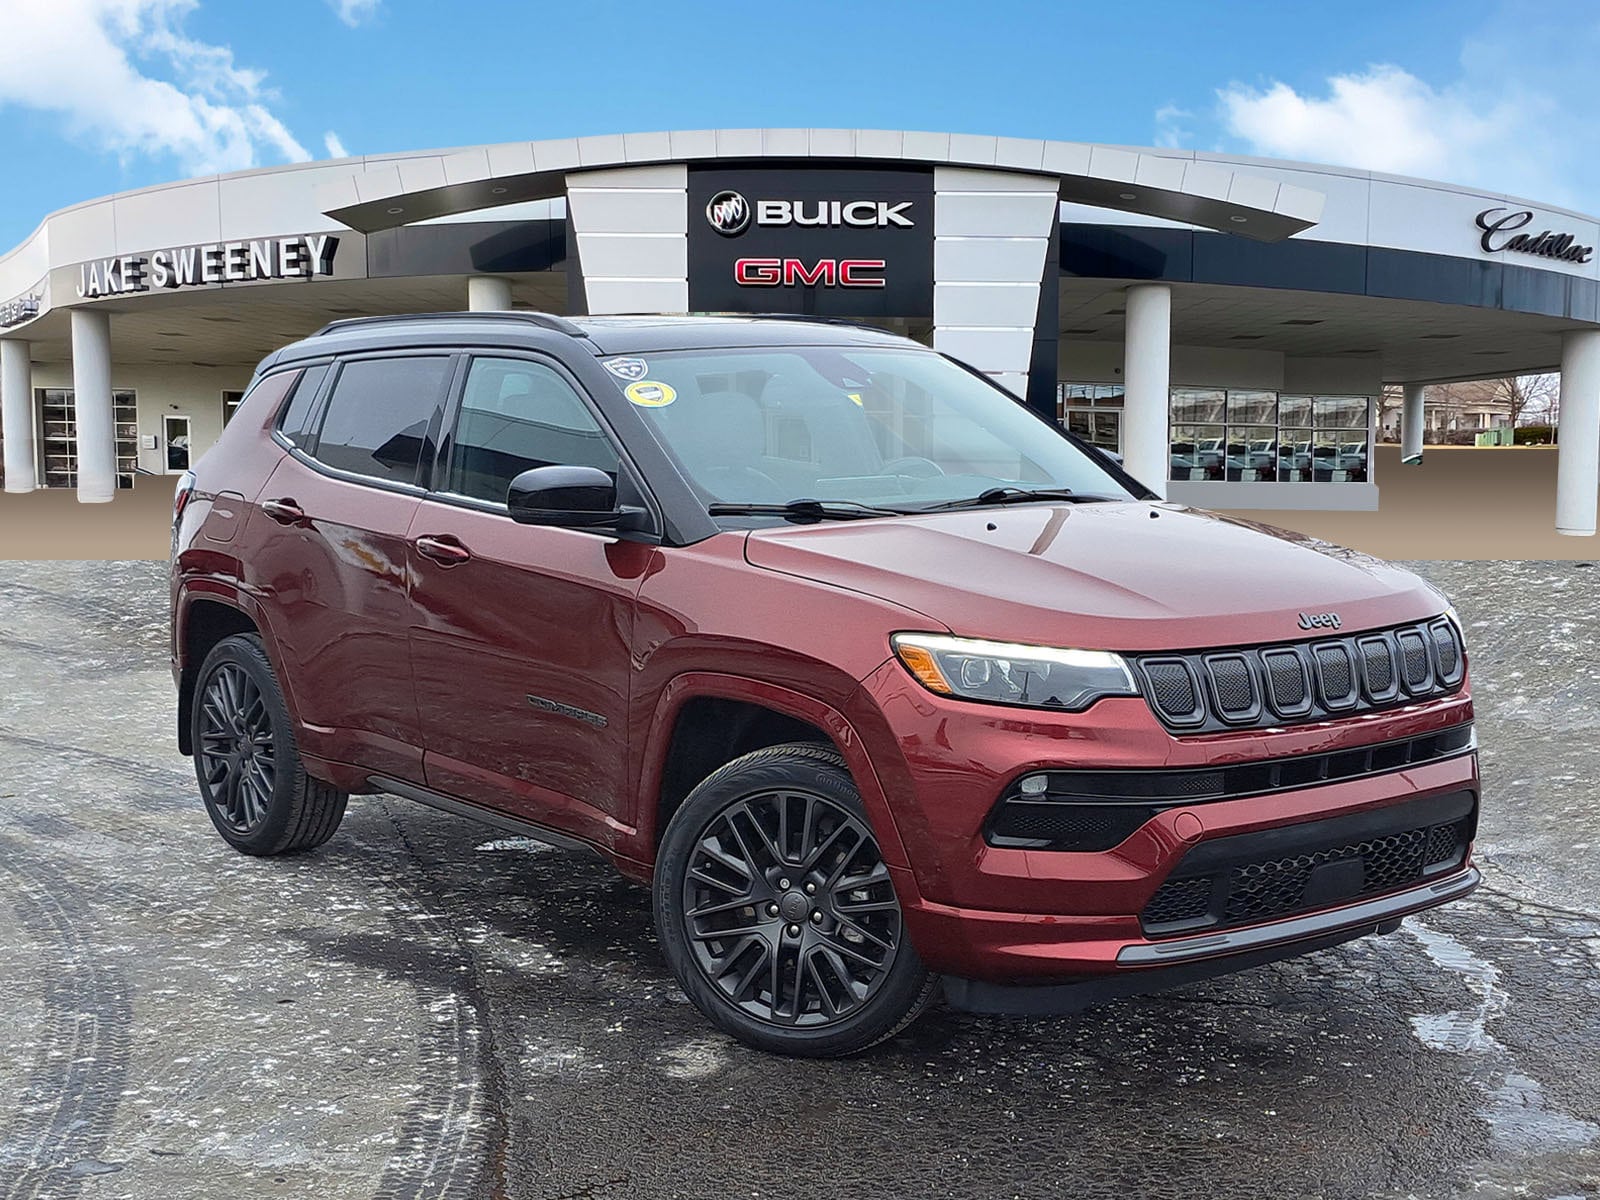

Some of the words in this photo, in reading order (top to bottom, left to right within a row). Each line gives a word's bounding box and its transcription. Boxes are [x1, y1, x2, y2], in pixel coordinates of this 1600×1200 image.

[757, 200, 915, 226] BUICK
[1475, 207, 1593, 263] Cadillac
[77, 256, 146, 298] JAKE
[152, 235, 336, 288] SWEENEY
[734, 258, 886, 287] GMC
[1297, 612, 1342, 630] Jeep
